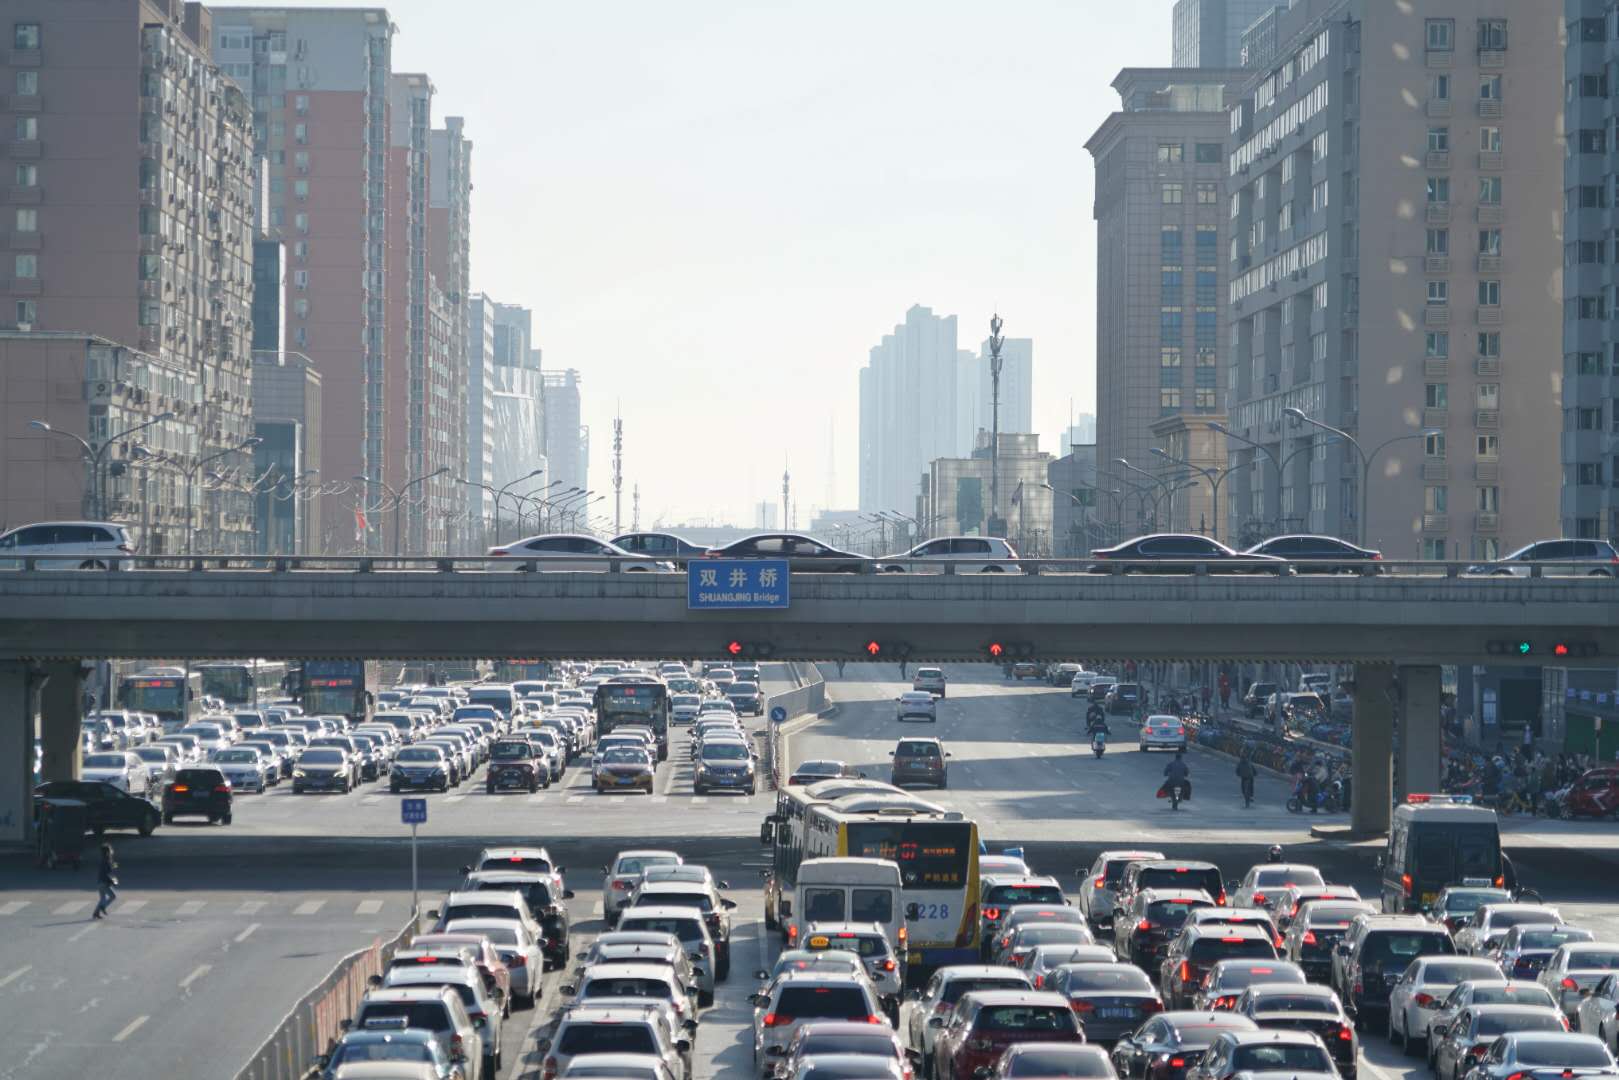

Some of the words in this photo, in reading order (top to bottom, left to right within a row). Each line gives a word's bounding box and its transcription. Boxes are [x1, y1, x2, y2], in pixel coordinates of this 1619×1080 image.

[700, 568, 777, 588] 双井桥
[698, 592, 751, 603] SHUANGJING
[753, 592, 779, 603] Bridge
